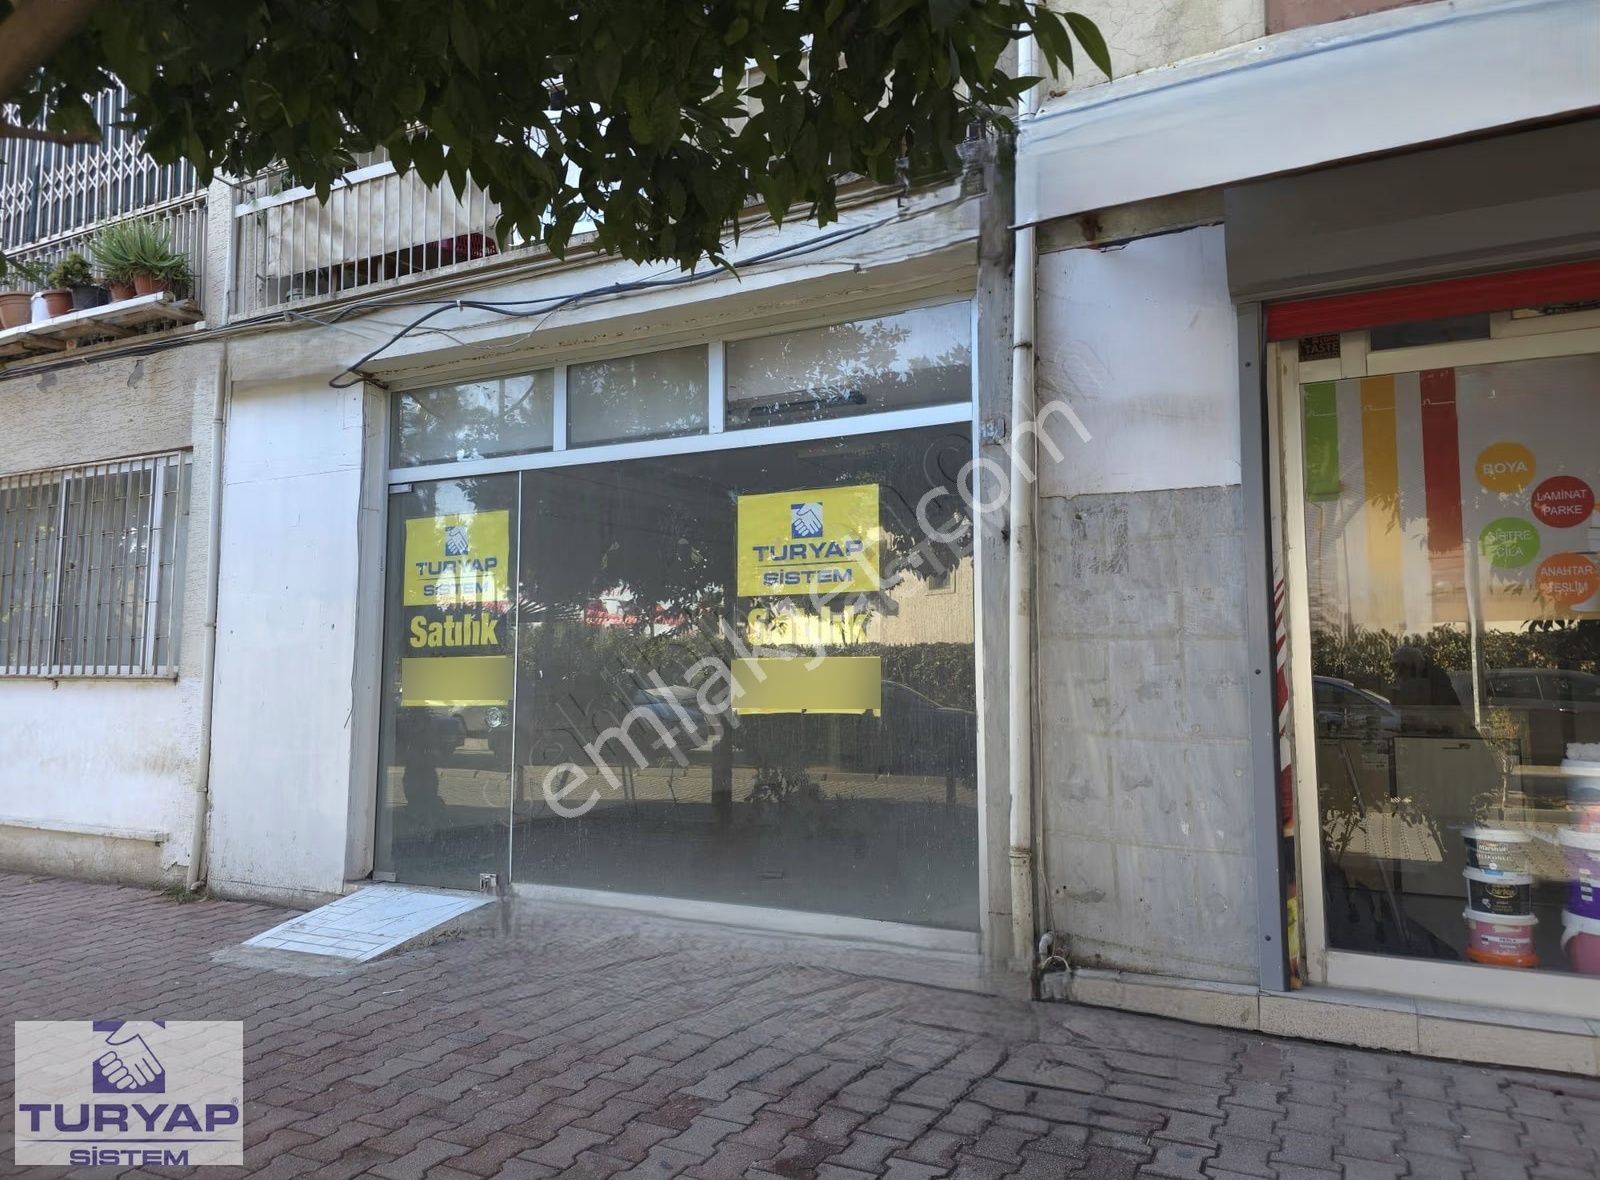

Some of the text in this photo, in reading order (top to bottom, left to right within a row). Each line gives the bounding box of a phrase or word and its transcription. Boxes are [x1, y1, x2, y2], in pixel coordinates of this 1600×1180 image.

[1483, 461, 1527, 474] BOYA
[1536, 488, 1587, 502] LAMİNAT
[1543, 504, 1583, 516] PARKE
[752, 539, 864, 562] TURYAP
[415, 557, 498, 577] TURYAP
[1541, 565, 1593, 578] ANAHTAR
[763, 568, 853, 586] SİSTEM
[409, 612, 499, 648] Satılık
